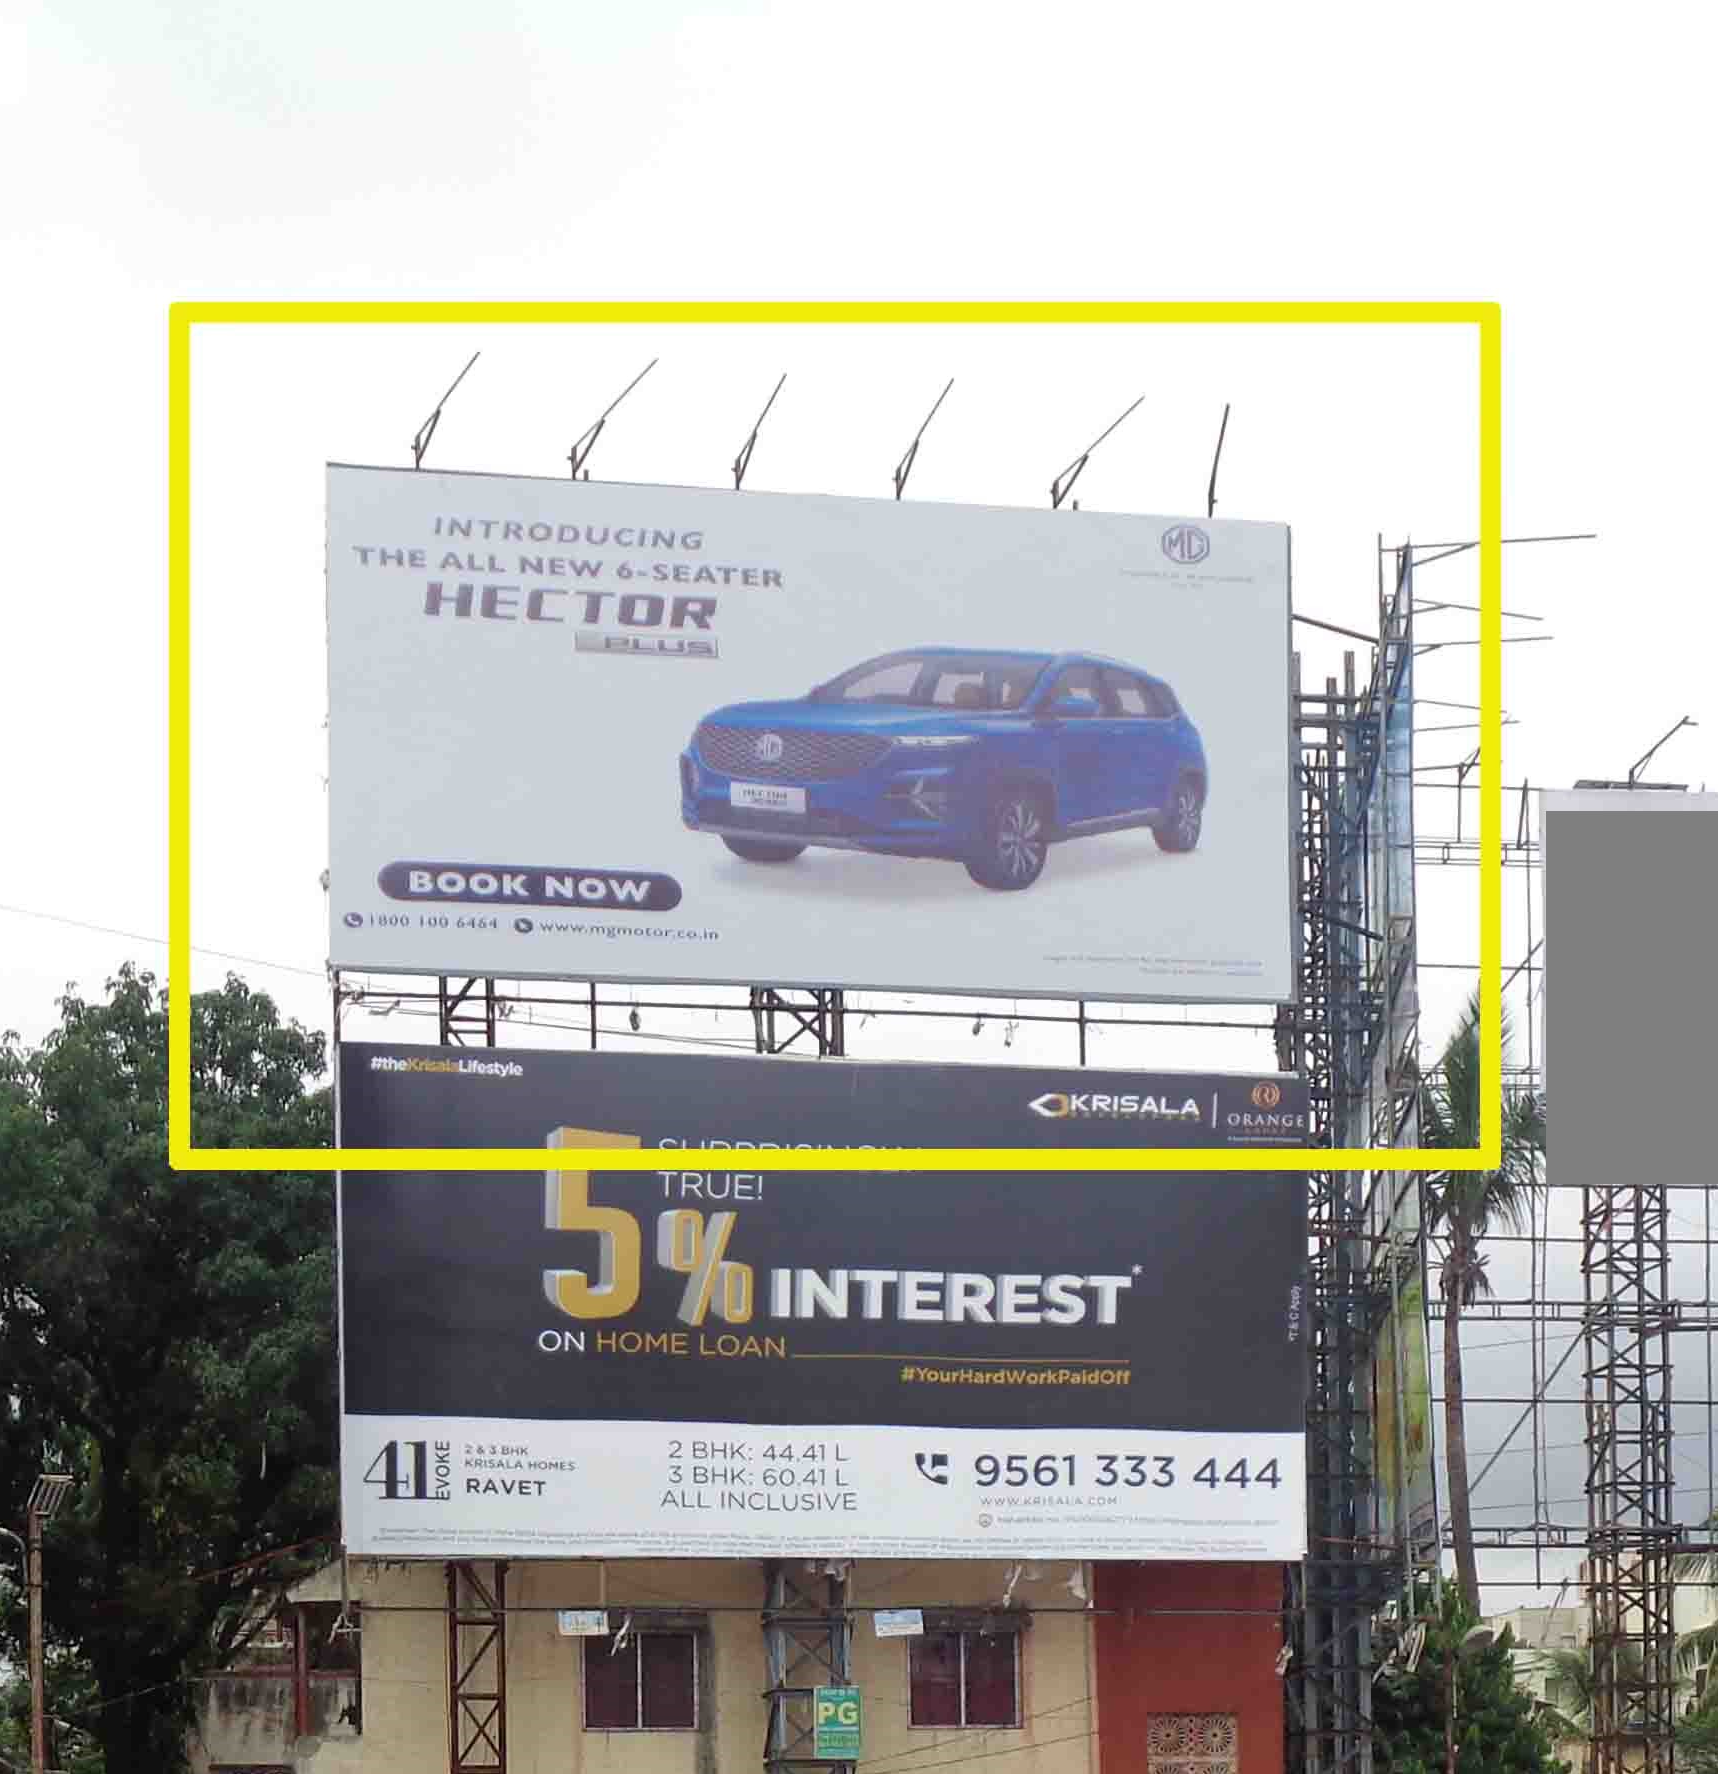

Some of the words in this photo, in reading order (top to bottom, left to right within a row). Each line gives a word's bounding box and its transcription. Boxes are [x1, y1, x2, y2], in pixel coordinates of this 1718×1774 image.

[434, 516, 704, 550] INTRODUCING
[352, 546, 427, 568] THE
[439, 550, 506, 574] ALL
[519, 556, 603, 579] NEW
[616, 560, 783, 589] 6-SEATER
[423, 580, 717, 630] HECTOR
[604, 635, 715, 657] PLUS
[408, 871, 530, 898] BOOK
[544, 875, 651, 903] NOW
[368, 912, 411, 928] 1800
[419, 913, 449, 930] 100
[455, 915, 499, 931] 6464
[539, 918, 719, 941] www.mgmotor.co.in
[371, 1056, 524, 1078] #theKrisalaLifestyle
[1071, 1092, 1200, 1117] KRISALA
[1228, 1113, 1305, 1129] ORANGE
[658, 1171, 764, 1200] TRUE!
[538, 1330, 584, 1353] ON
[597, 1331, 687, 1355] HOME
[700, 1334, 786, 1358] LOAN
[900, 1366, 1132, 1385] #YourHardWorkPaidOff
[501, 1446, 529, 1456] BHK
[668, 1440, 683, 1459] 2
[692, 1441, 753, 1461] BHK:
[763, 1443, 826, 1462] 44.41
[835, 1444, 850, 1462] L
[363, 1440, 428, 1500] 41
[434, 1440, 451, 1500] EVOKE
[465, 1458, 523, 1471] KRISALA
[528, 1461, 576, 1472] HOMES
[974, 1454, 1077, 1488] 9561
[1095, 1455, 1176, 1489] 333
[1193, 1457, 1282, 1490] 444
[466, 1477, 547, 1497] RAVET
[668, 1466, 683, 1485] 3
[692, 1467, 753, 1486] BHK:
[763, 1468, 826, 1487] 60.41
[835, 1468, 850, 1487] L
[661, 1490, 711, 1510] ALL
[721, 1491, 858, 1512] INCLUSIVE
[819, 1702, 859, 1724] PG
